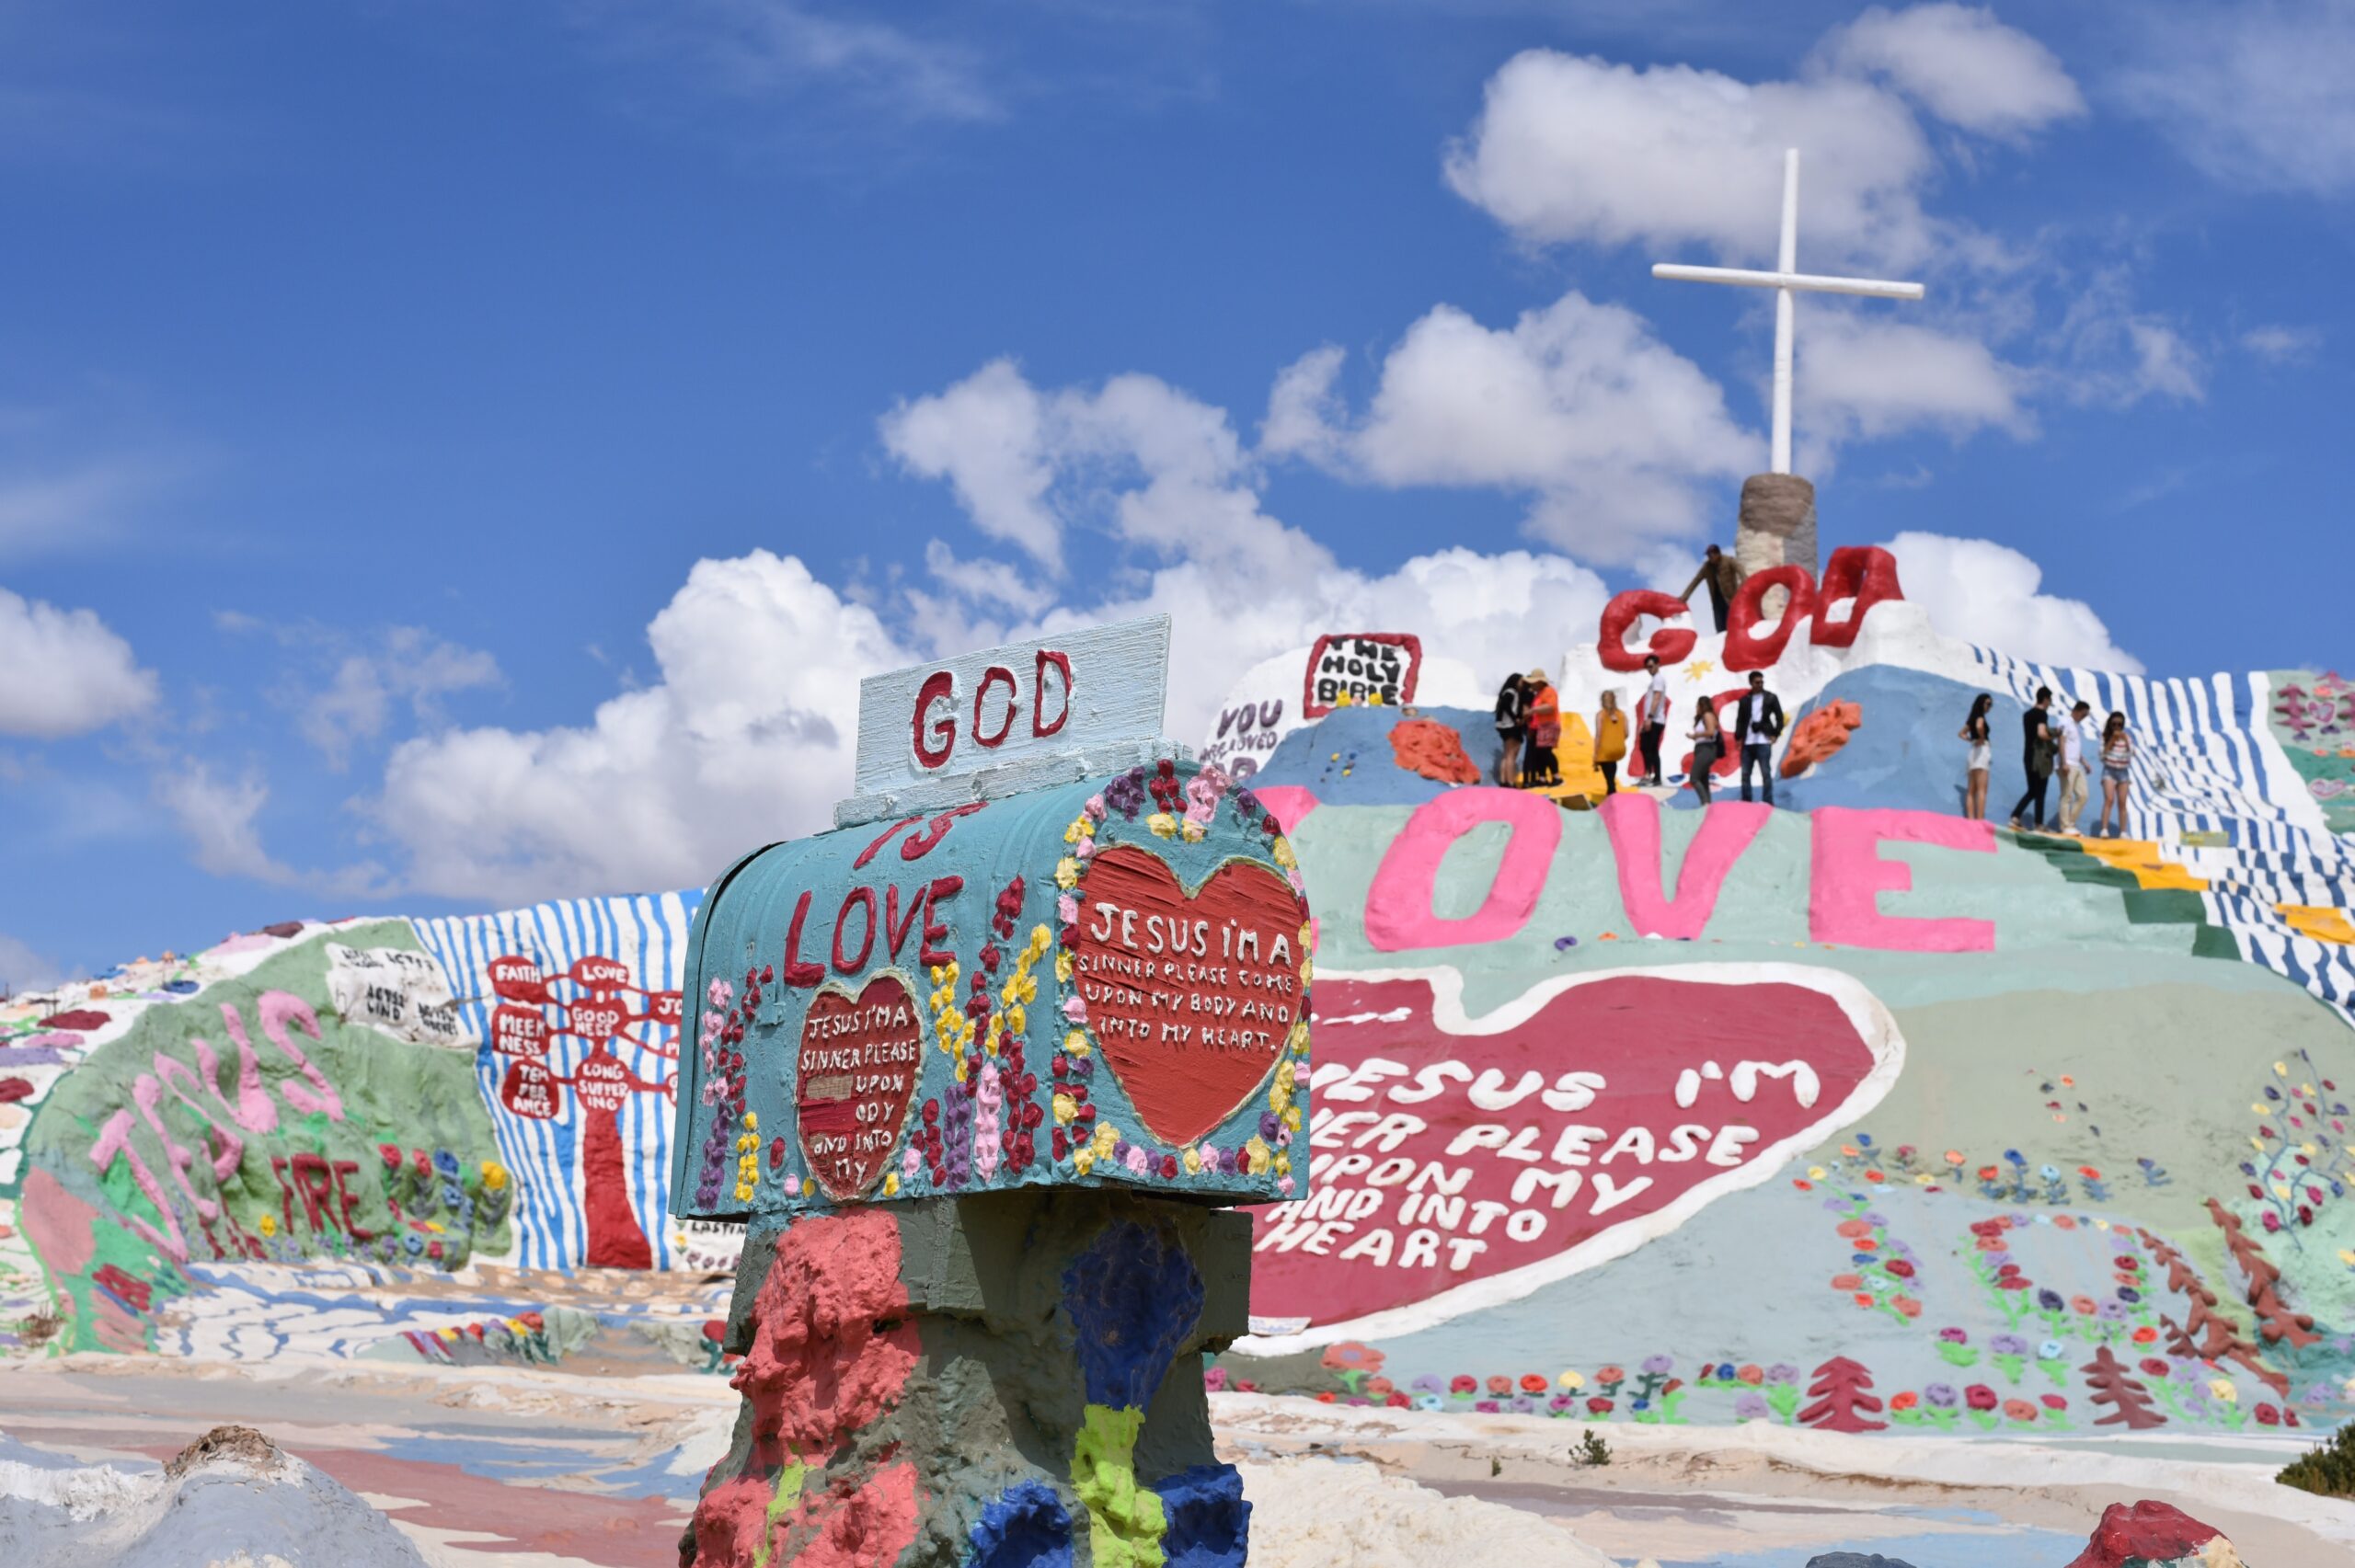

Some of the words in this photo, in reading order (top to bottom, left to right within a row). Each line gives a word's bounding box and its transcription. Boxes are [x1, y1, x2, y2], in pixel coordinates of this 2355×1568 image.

[1598, 545, 1906, 672] GOD
[1330, 637, 1397, 662] THE
[1322, 656, 1399, 684] HOLY
[913, 649, 1073, 769] GOD
[1217, 699, 1282, 739] YOU
[1229, 731, 1277, 751] LOVED
[853, 801, 989, 869] IS
[784, 876, 964, 989] LOVE
[1090, 901, 1209, 958] JESUS
[1269, 933, 1292, 968] A
[495, 965, 542, 984] FAITH
[581, 965, 628, 984] LOVE
[1078, 955, 1156, 978] SINNER
[1164, 963, 1228, 985] PLEASE
[1238, 970, 1293, 993] COME
[571, 1007, 619, 1025] GOOD
[1085, 983, 1143, 1006] UPON
[1151, 991, 1184, 1012] MY
[1190, 993, 1236, 1015] BODY
[1241, 1001, 1289, 1024] AND
[809, 1012, 861, 1039] JESUS
[892, 1006, 908, 1028] A
[1100, 1016, 1151, 1039] INTO
[1161, 1022, 1192, 1044] MY
[1201, 1026, 1277, 1051] HEART.
[499, 1035, 542, 1056] NESS
[801, 1047, 861, 1071] SINNER
[864, 1038, 917, 1065] PLEASE
[519, 1064, 550, 1083] TEM
[582, 1063, 625, 1081] LONG
[855, 1073, 903, 1094] UPON
[1675, 1060, 1821, 1109] I'M
[578, 1080, 629, 1098] SUFFER
[587, 1095, 619, 1112] ING
[512, 1095, 552, 1117] ANCE
[855, 1101, 895, 1124] ODY
[855, 1127, 892, 1151] INTO
[1444, 1124, 1760, 1167] PLEASE
[834, 1157, 868, 1187] MY
[1511, 1168, 1654, 1216] MY
[691, 1221, 747, 1235] LASTIN
[1397, 1192, 1547, 1242] INTO
[1253, 1219, 1488, 1271] HEART
